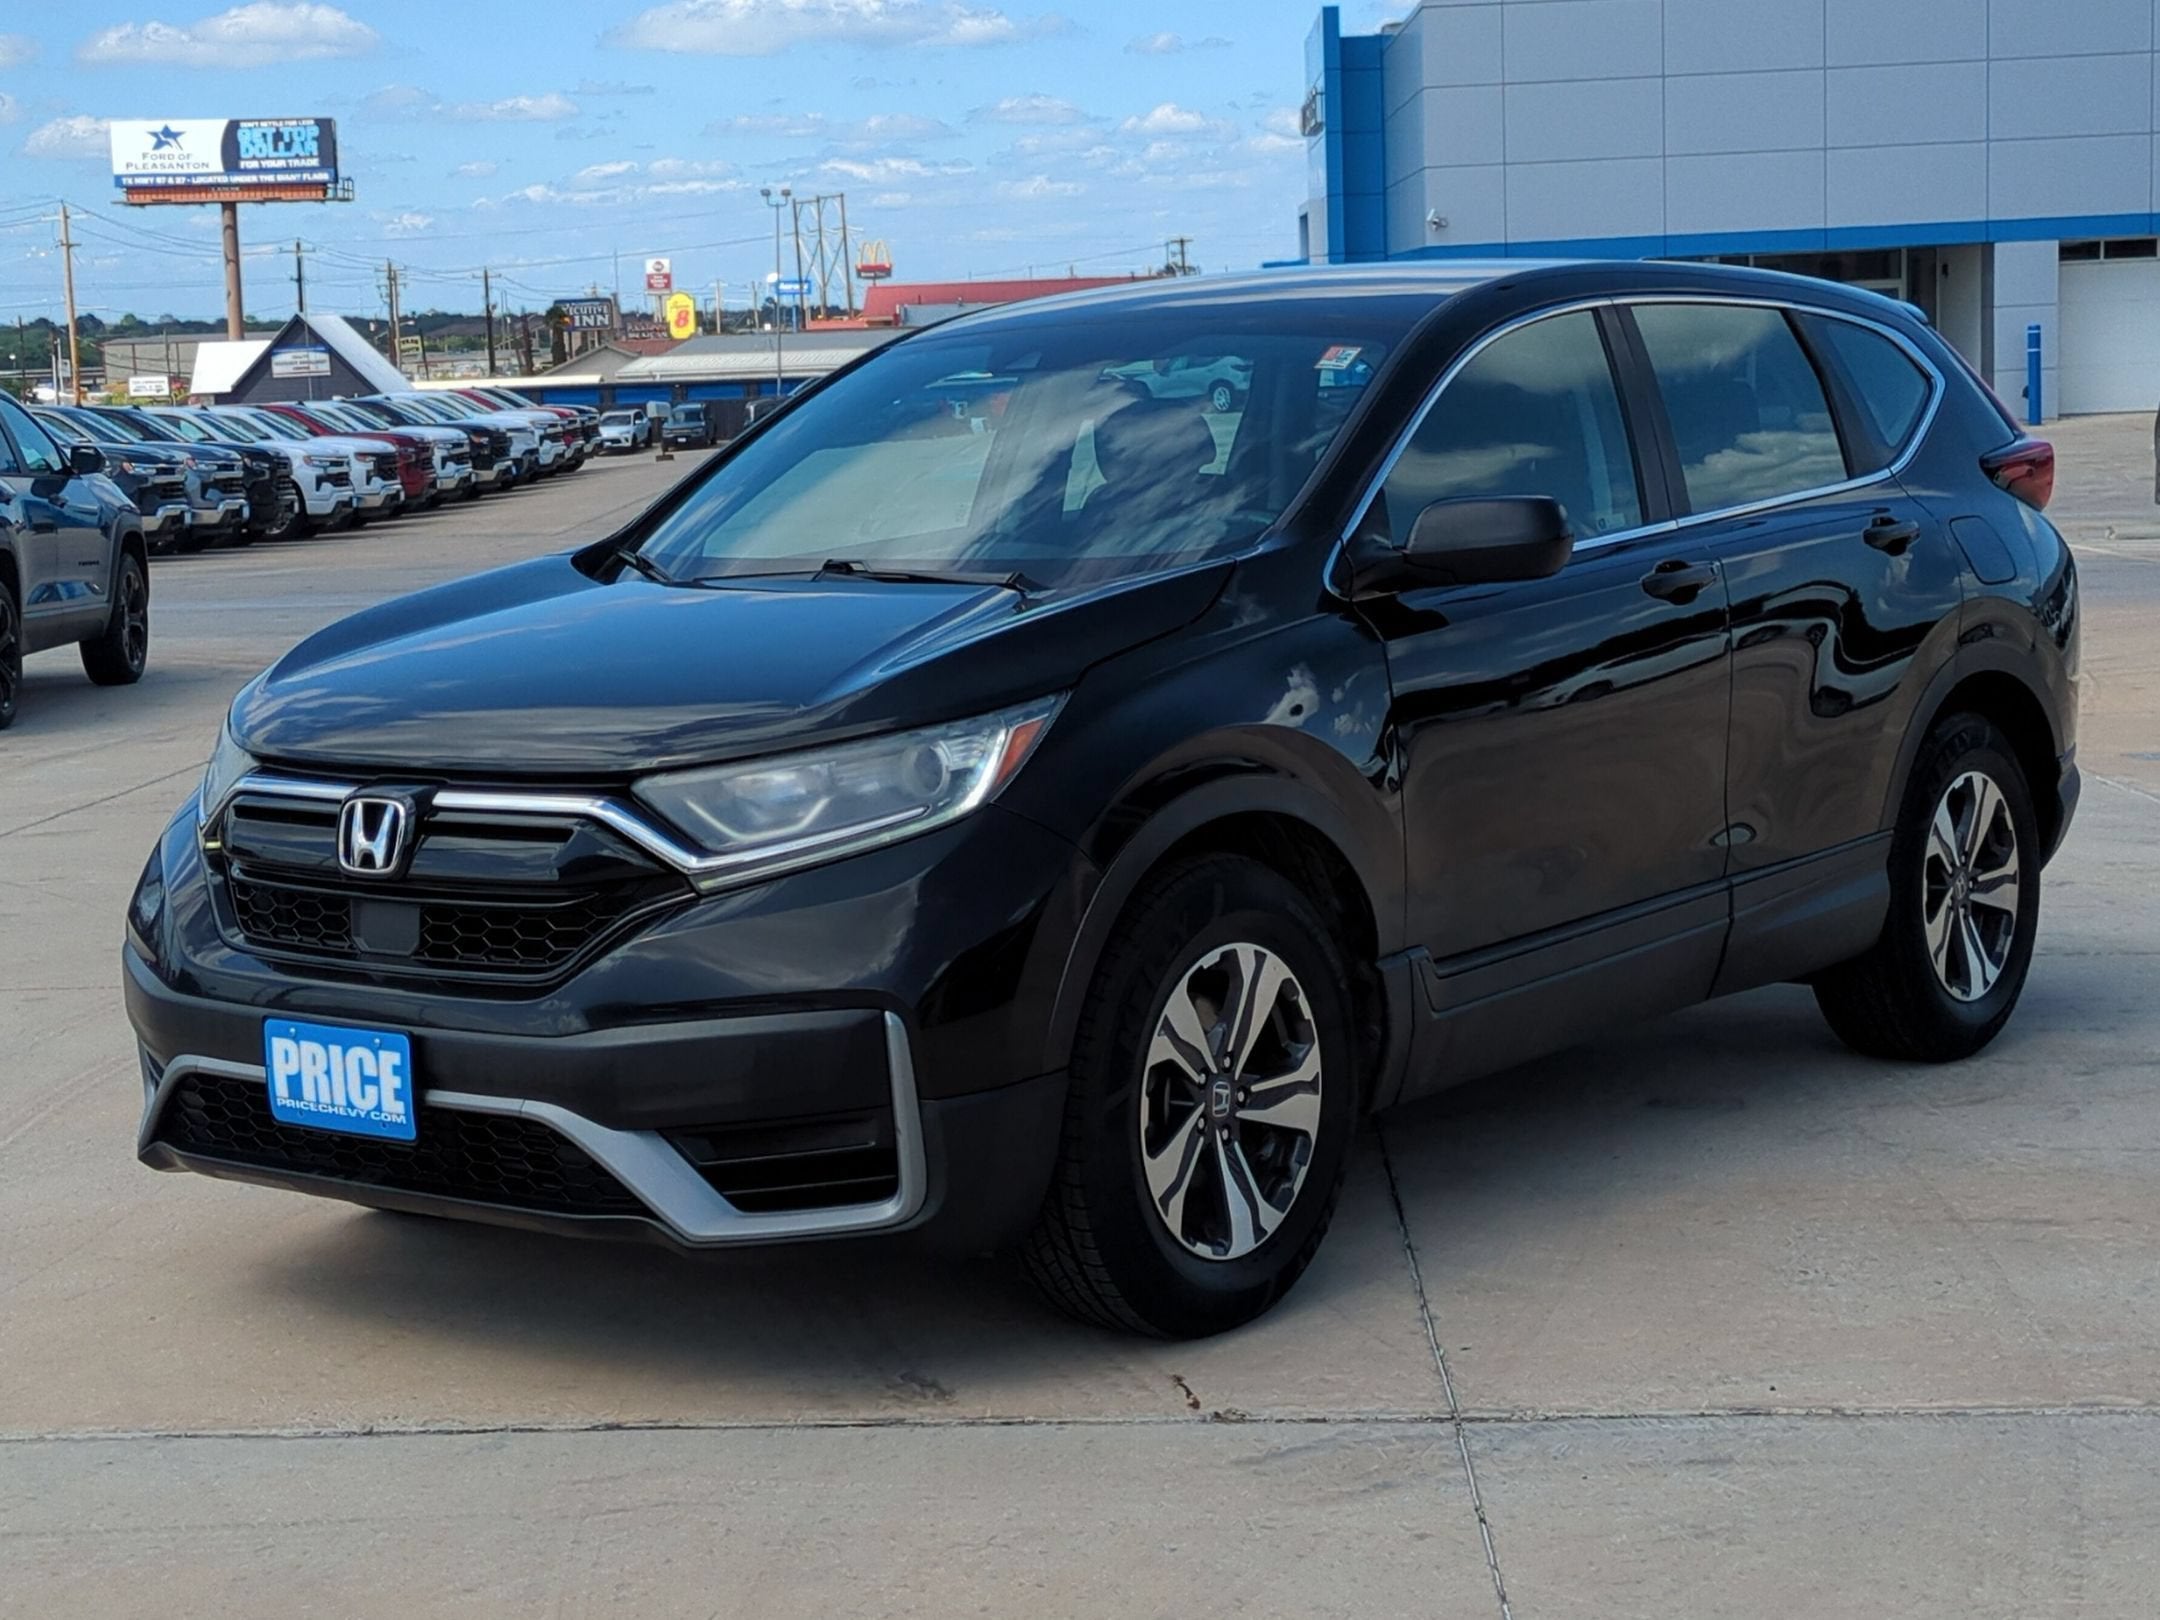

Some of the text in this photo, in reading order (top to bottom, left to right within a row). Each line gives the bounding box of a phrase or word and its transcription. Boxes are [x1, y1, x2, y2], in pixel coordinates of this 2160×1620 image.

[280, 125, 320, 142] TOP
[240, 140, 318, 159] DOLLAR
[142, 152, 193, 161] FORD OF
[239, 157, 320, 169] FOR YOUR TRADE
[125, 162, 209, 171] PLEASANTON
[122, 177, 133, 185] TX
[192, 175, 228, 184] LOCATED
[230, 174, 258, 183] UNDER
[258, 174, 275, 182] THE
[303, 172, 330, 181] FLAGS
[561, 303, 609, 315] ECUTIVE
[574, 314, 609, 327] INN
[675, 309, 690, 328] 8
[271, 1036, 406, 1114] PRICE
